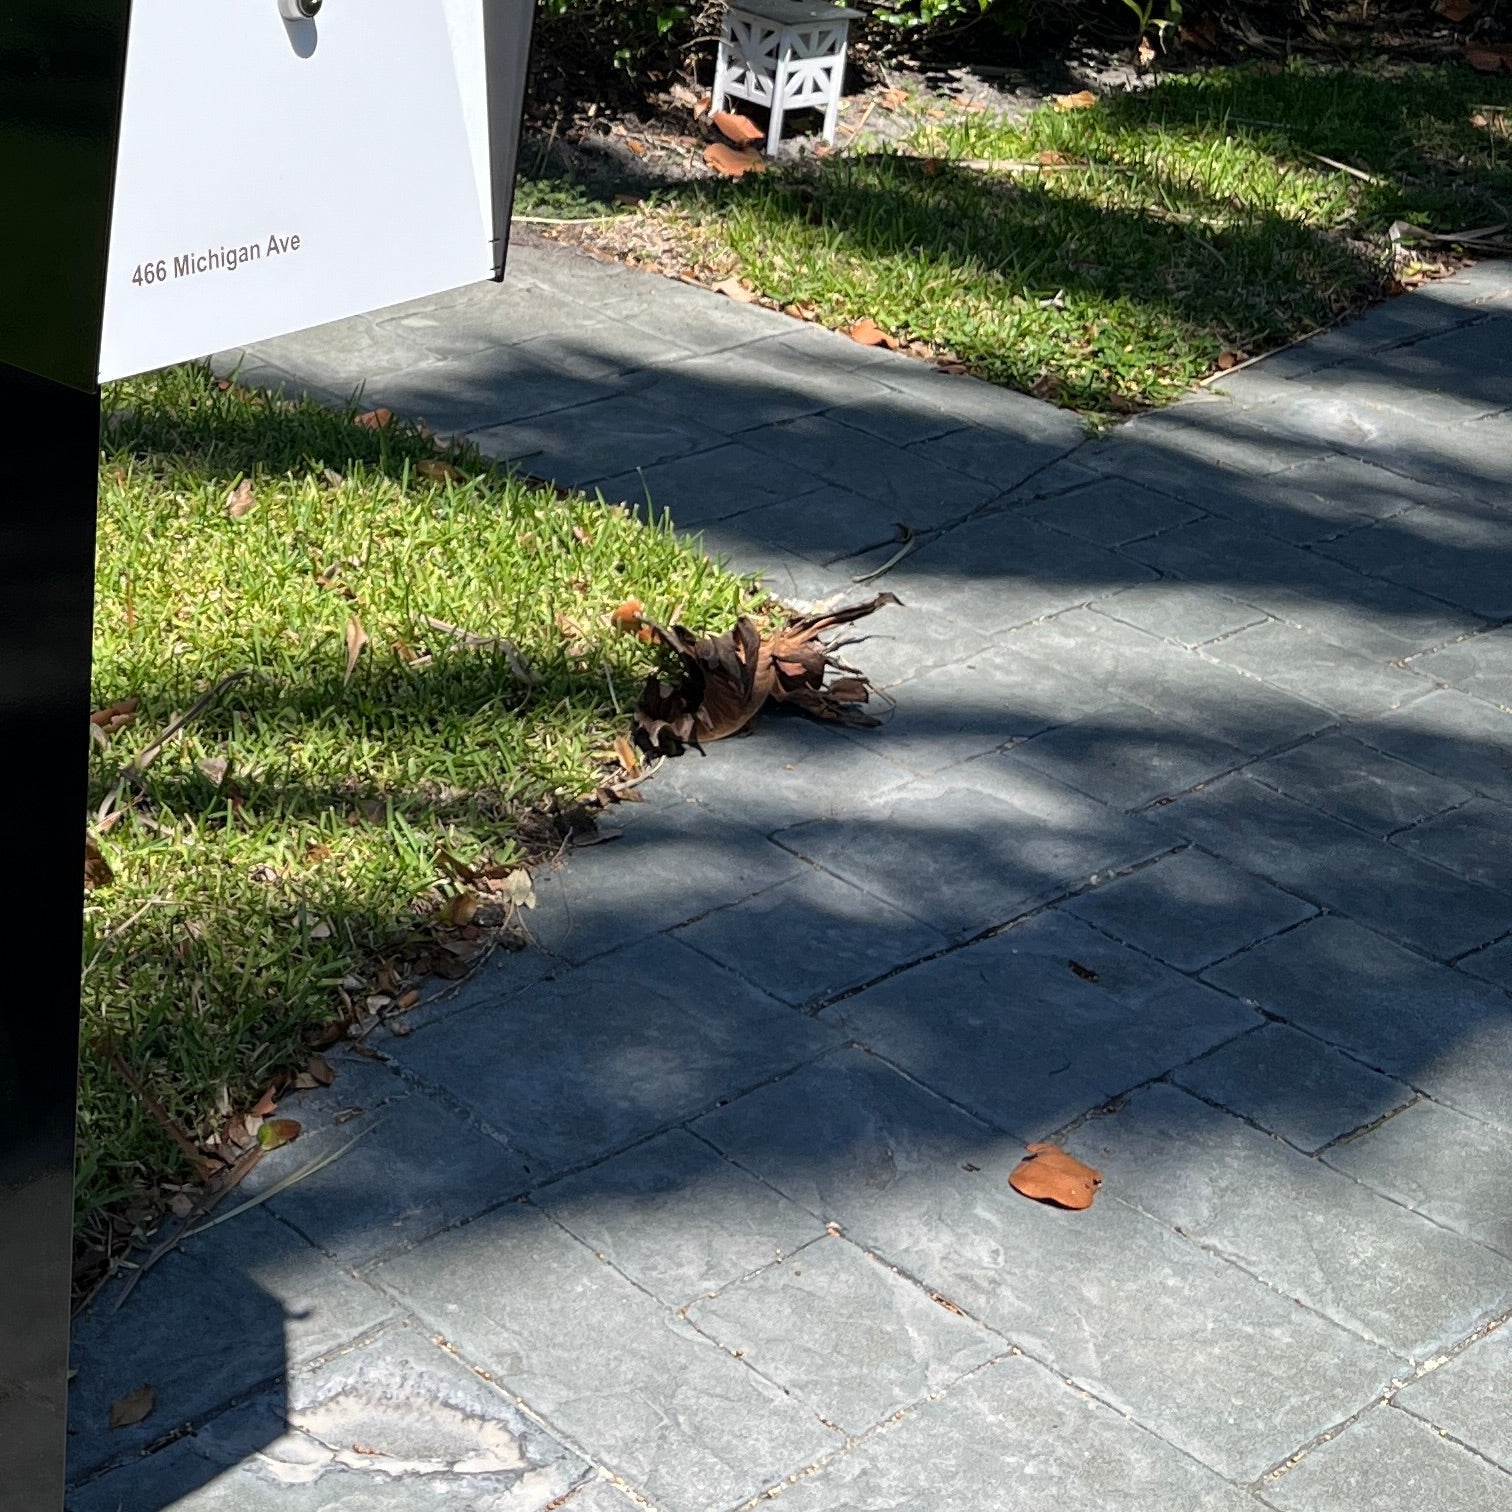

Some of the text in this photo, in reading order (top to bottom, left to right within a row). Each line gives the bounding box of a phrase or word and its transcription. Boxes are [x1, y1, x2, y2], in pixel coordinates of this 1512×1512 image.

[132, 234, 301, 286] 466 Michigan Ave
